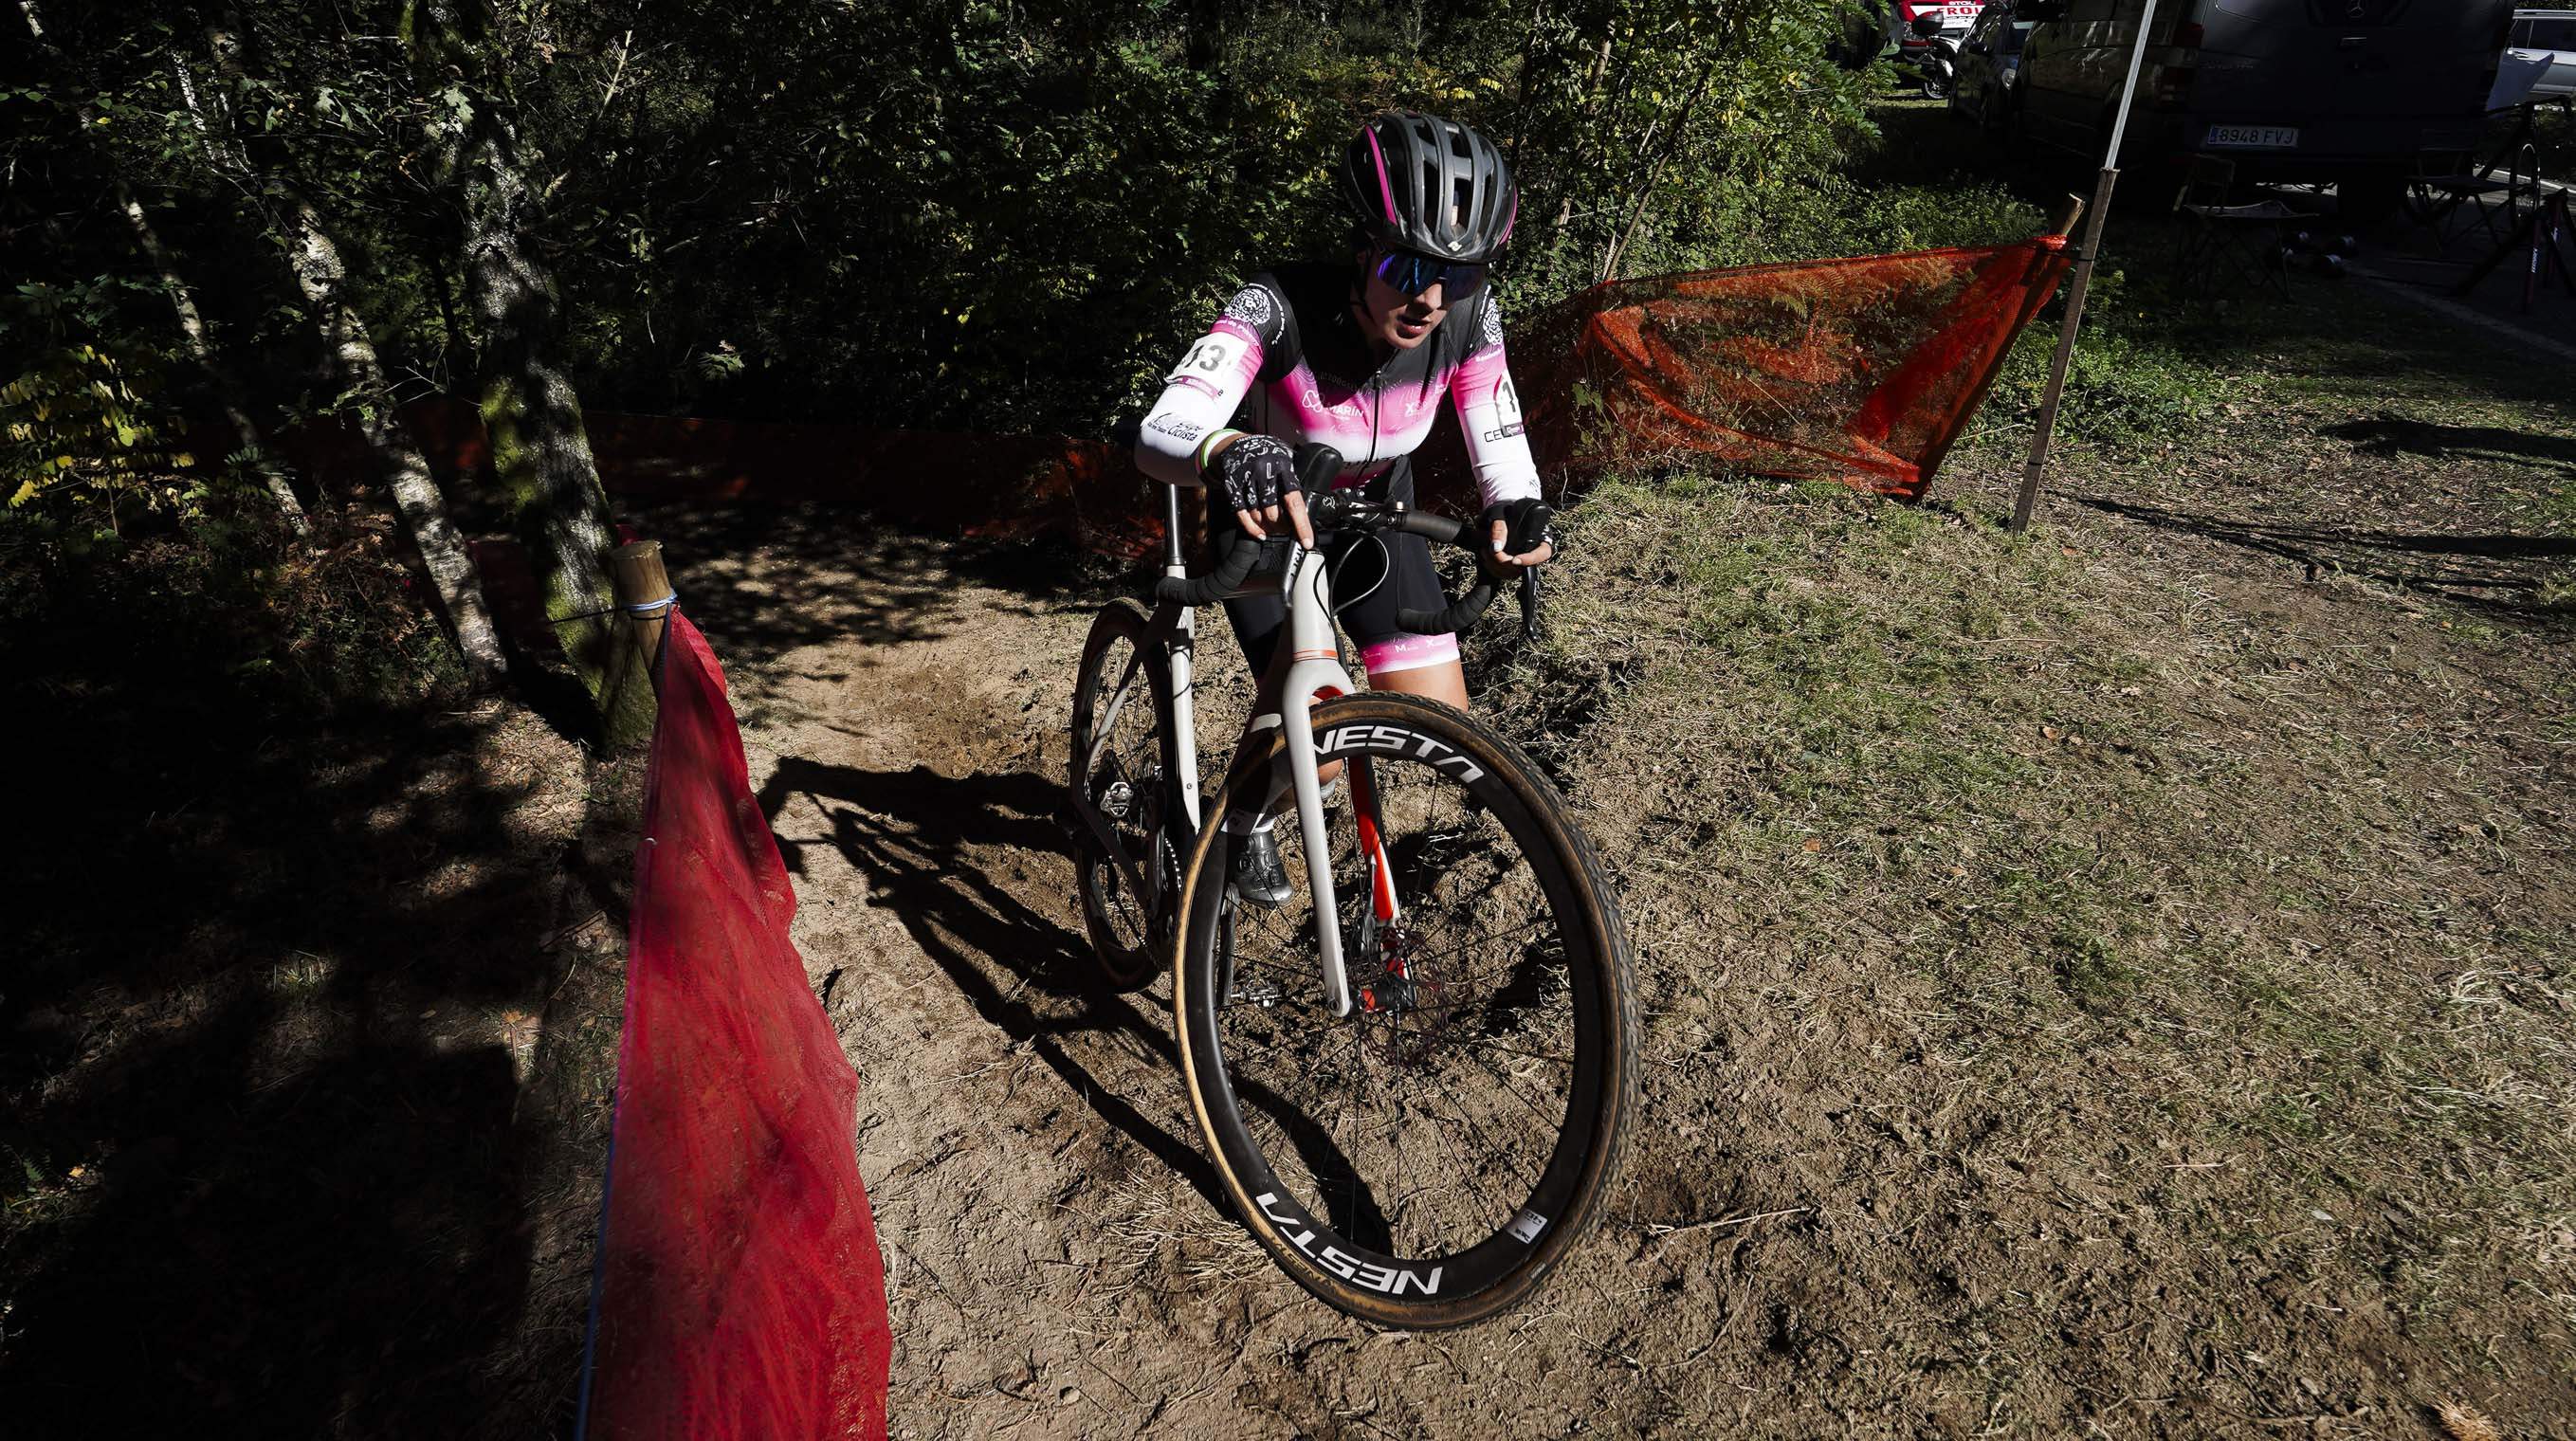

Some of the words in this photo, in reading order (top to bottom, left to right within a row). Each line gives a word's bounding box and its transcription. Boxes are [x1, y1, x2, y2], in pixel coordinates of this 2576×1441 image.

[2220, 128, 2259, 143] 8948
[2263, 128, 2294, 145] FVJ
[1255, 1192, 1443, 1295] NESTA
